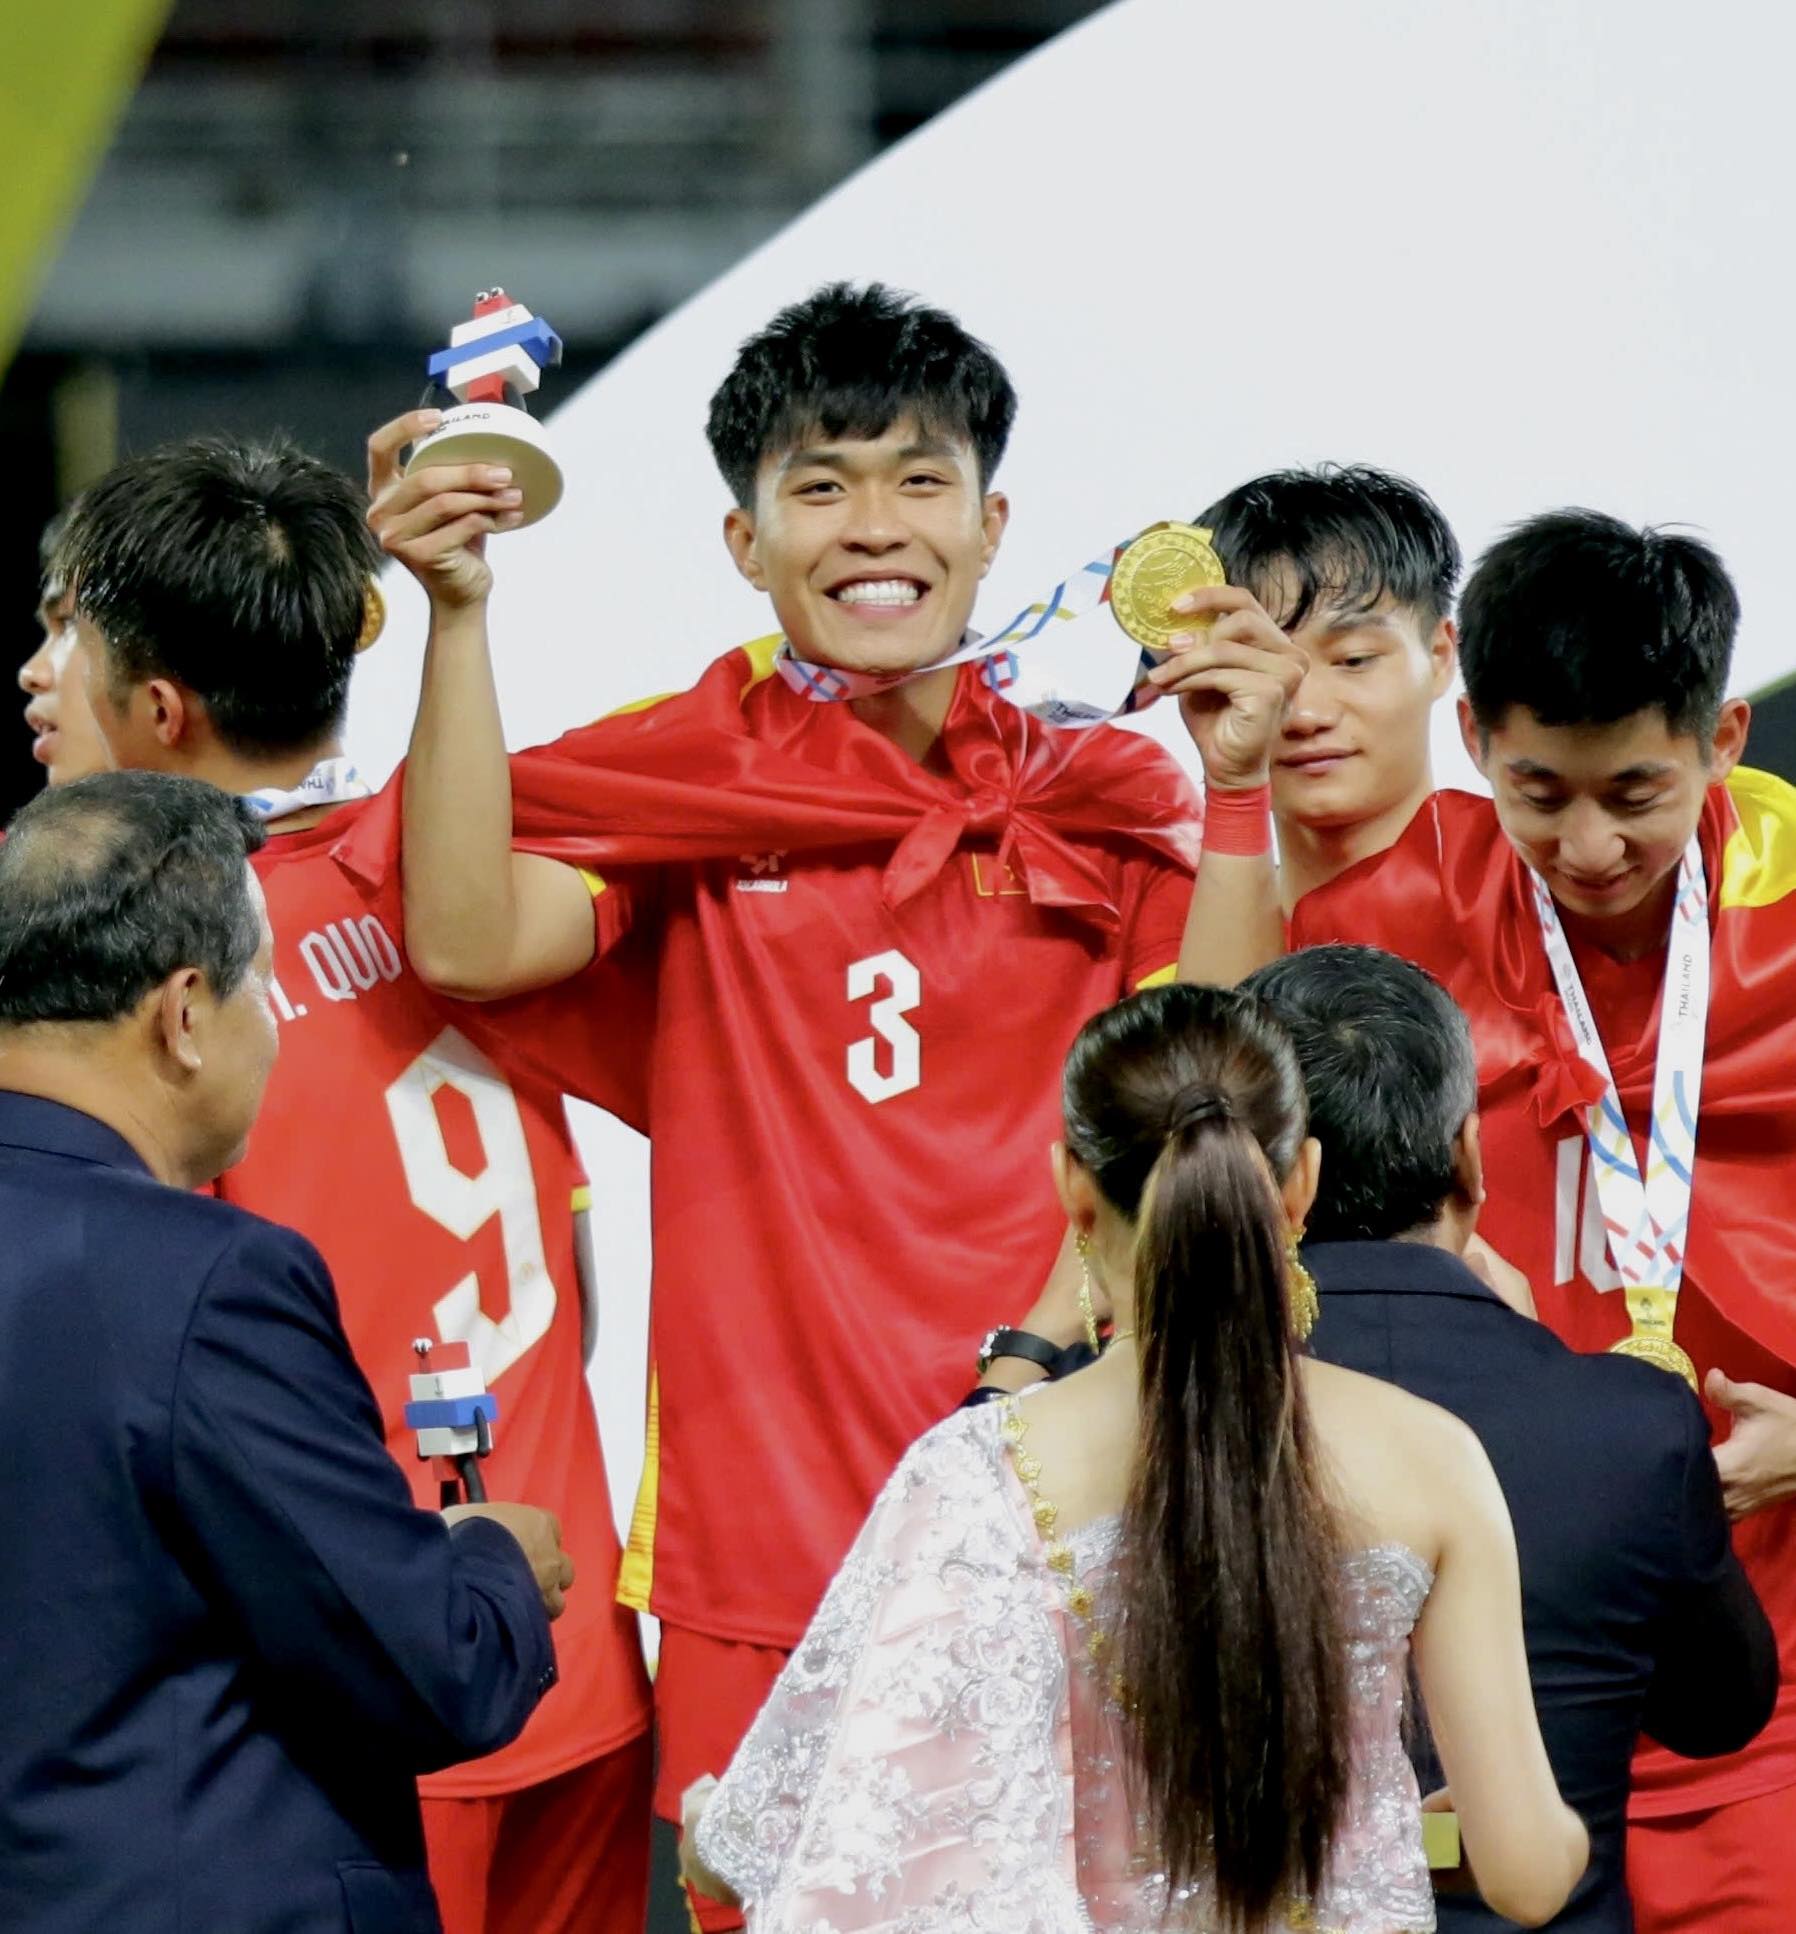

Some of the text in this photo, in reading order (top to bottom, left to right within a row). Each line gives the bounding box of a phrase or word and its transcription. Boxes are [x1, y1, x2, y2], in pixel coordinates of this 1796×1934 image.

[847, 949, 921, 1104] 3
[1678, 953, 1693, 1017] THAILAND
[385, 1024, 557, 1387] 9
